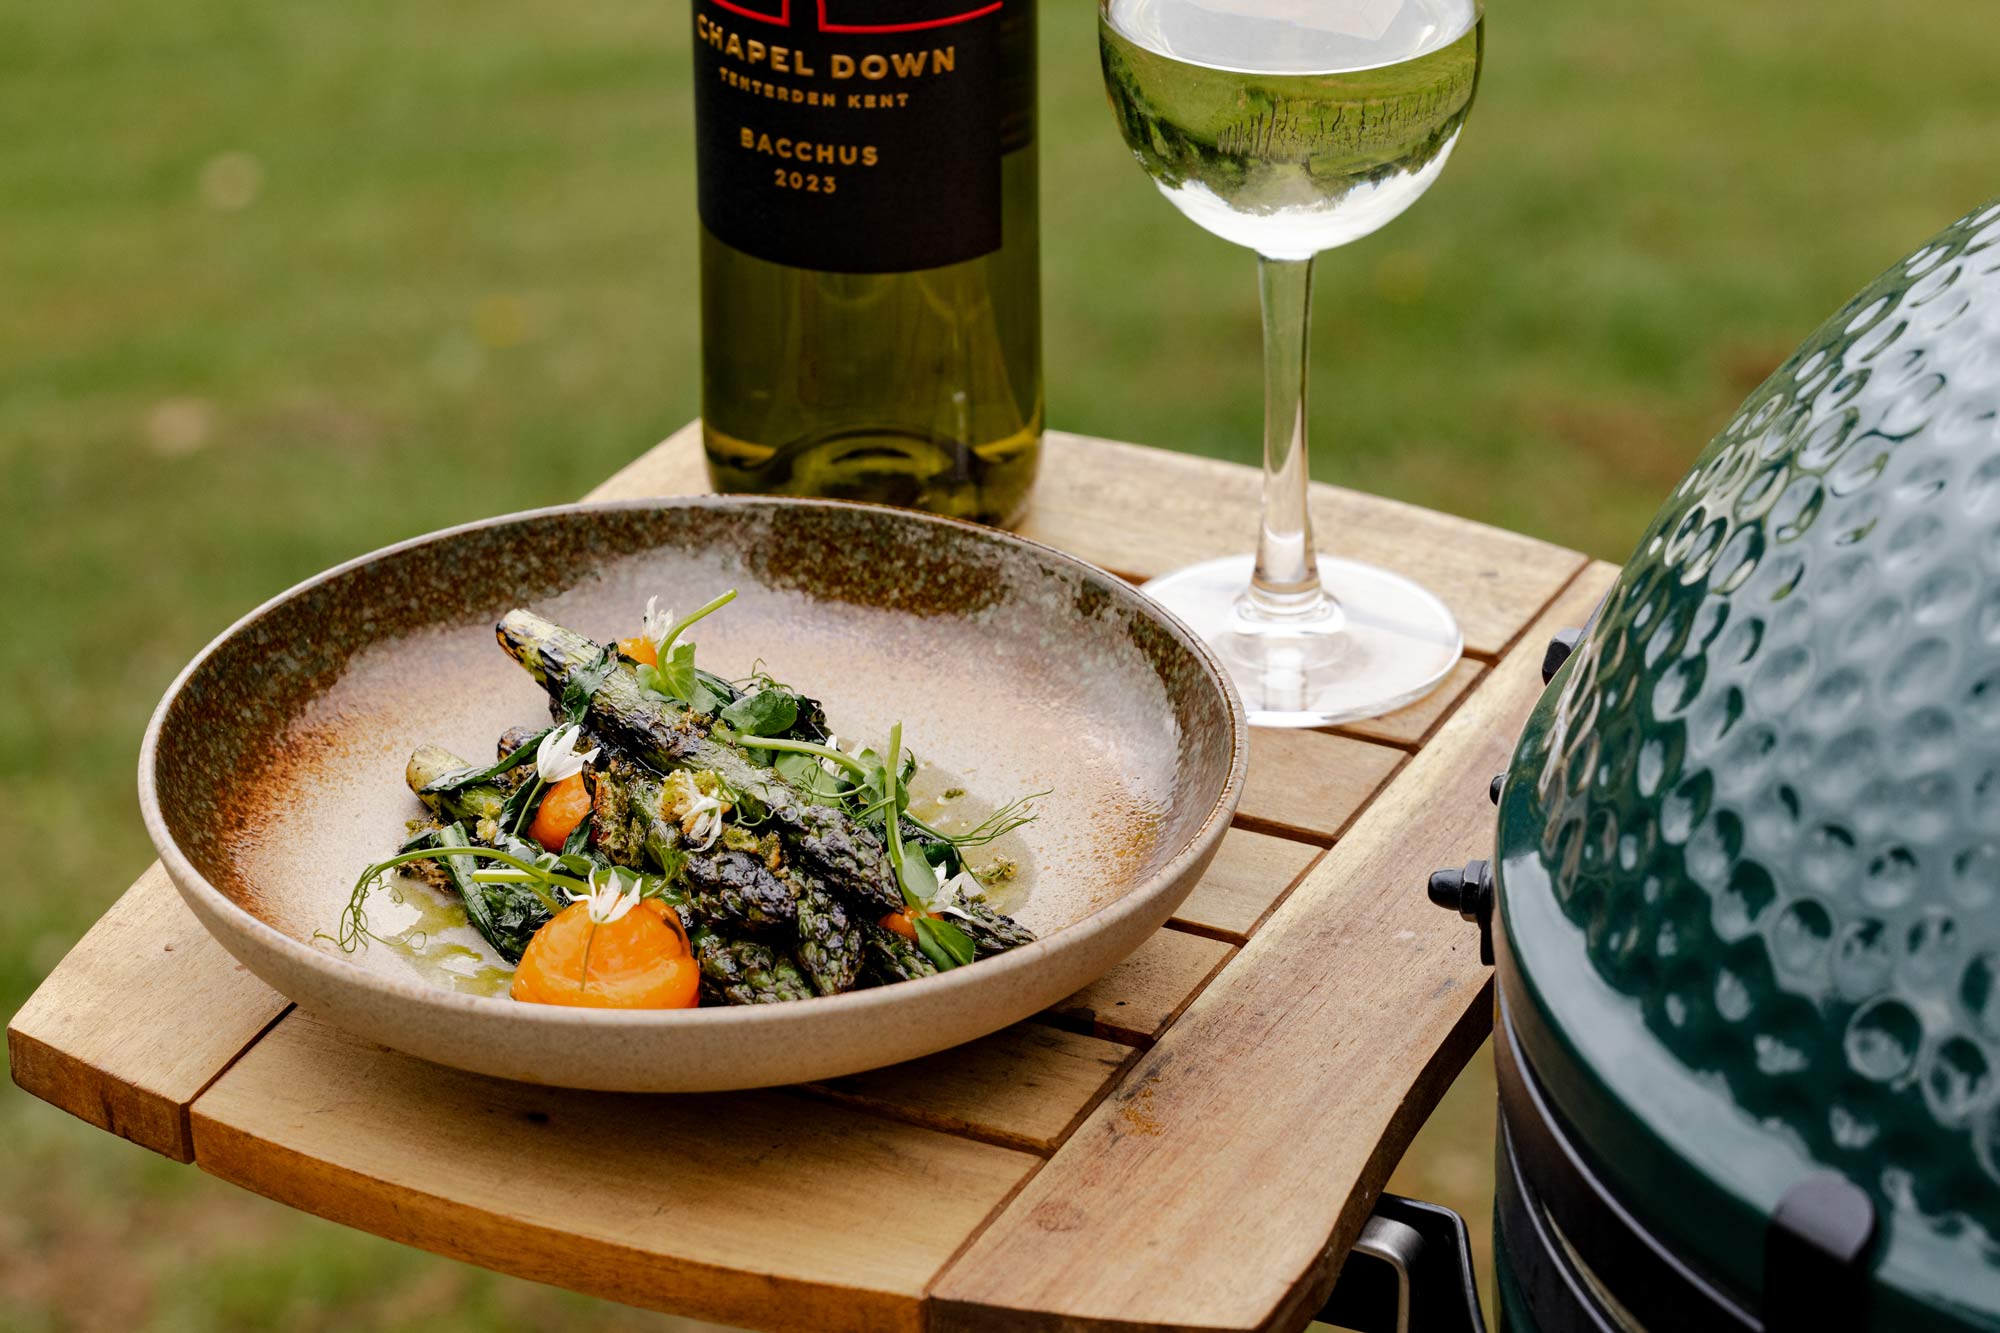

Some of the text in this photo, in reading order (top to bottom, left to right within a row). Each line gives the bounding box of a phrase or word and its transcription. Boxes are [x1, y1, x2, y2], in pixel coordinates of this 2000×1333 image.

[697, 13, 954, 80] CHAPEL DOWN
[719, 66, 909, 109] TENTERDEN KENT
[741, 127, 878, 167] BACCHUS
[775, 168, 836, 194] 2023
